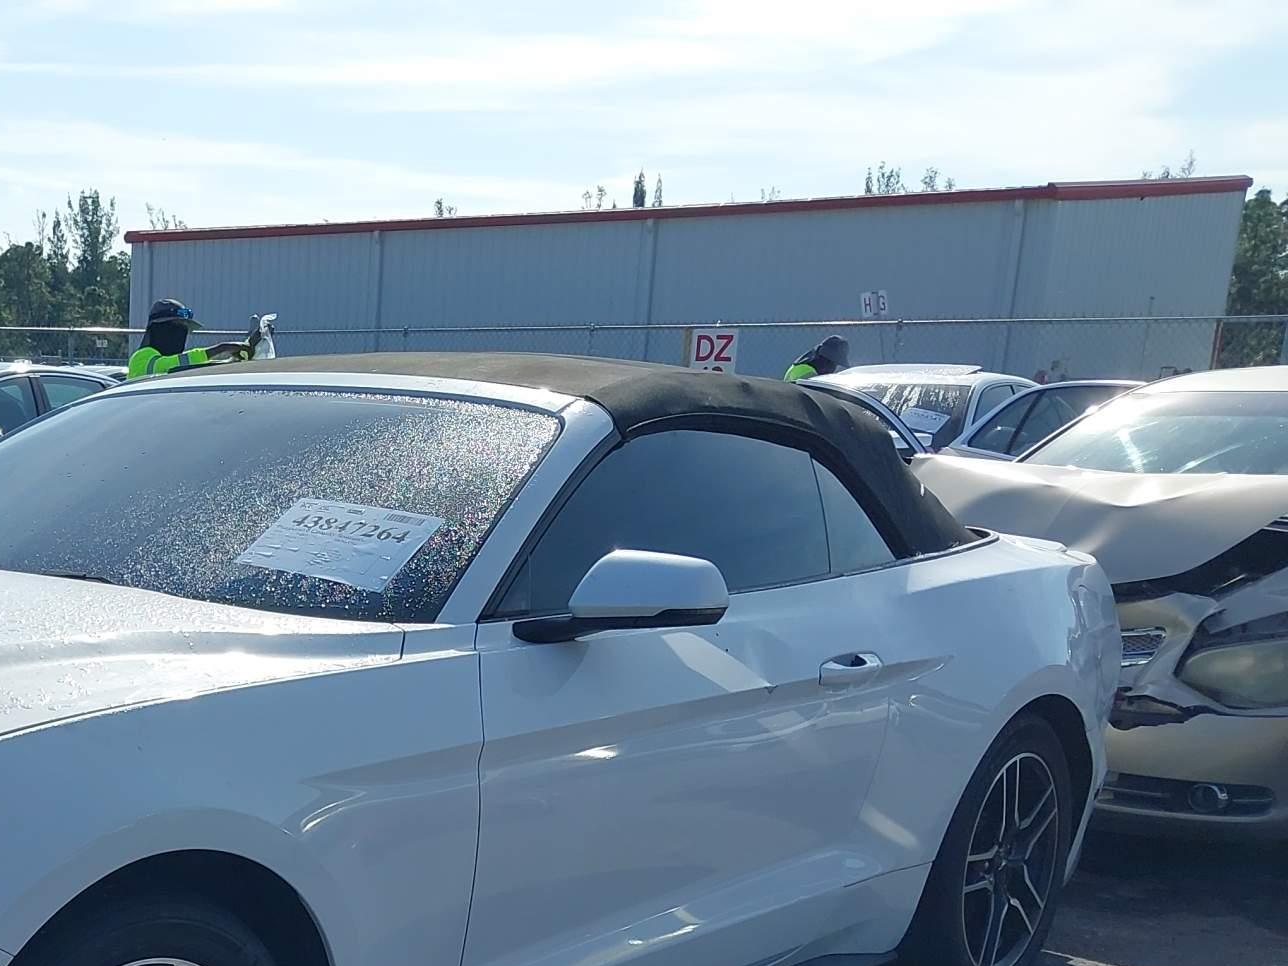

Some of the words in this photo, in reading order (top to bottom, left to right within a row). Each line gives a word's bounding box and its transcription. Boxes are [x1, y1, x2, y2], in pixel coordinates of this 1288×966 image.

[864, 297, 872, 313] H
[695, 334, 734, 362] DZ
[292, 515, 411, 543] 43847264
